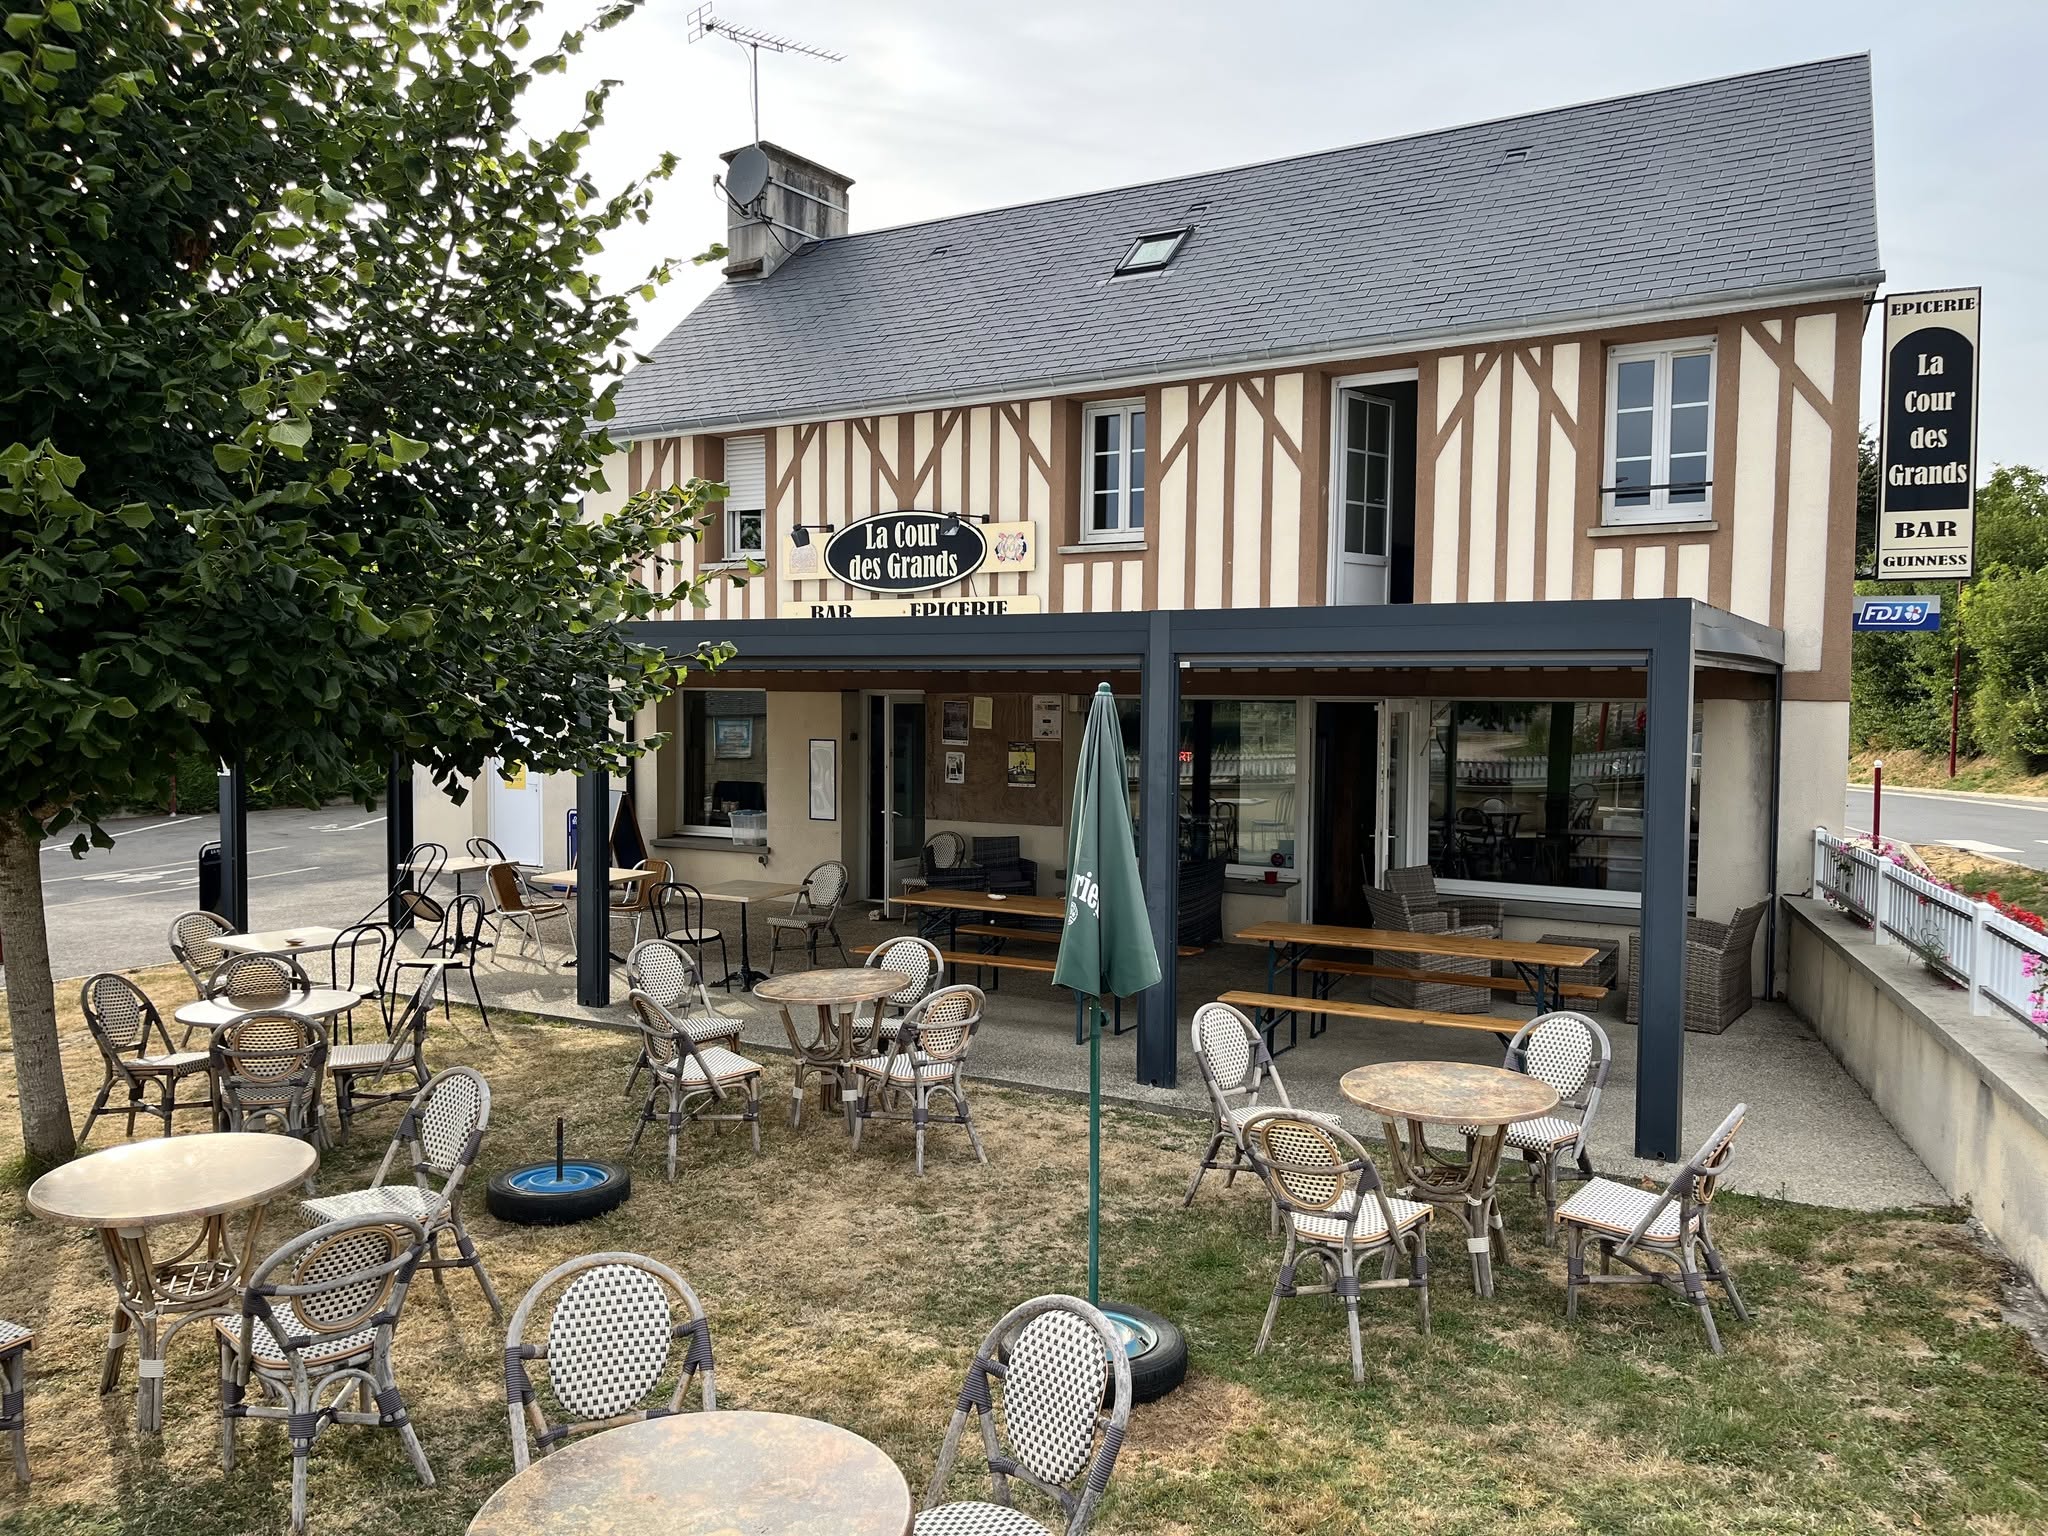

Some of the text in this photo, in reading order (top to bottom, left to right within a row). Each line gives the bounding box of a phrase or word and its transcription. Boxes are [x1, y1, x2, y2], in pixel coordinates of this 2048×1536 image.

[1890, 297, 1976, 317] EPICERIE
[1917, 353, 1944, 377] La
[1904, 389, 1956, 414] Cour
[1910, 426, 1948, 450] des
[1888, 461, 1968, 487] Grands
[864, 521, 940, 550] La Cour
[1894, 520, 1958, 539] BAR
[849, 550, 958, 581] des Grands
[1882, 553, 1968, 568] GUINNESS
[810, 604, 852, 619] BAR
[1864, 605, 1903, 621] FDJ
